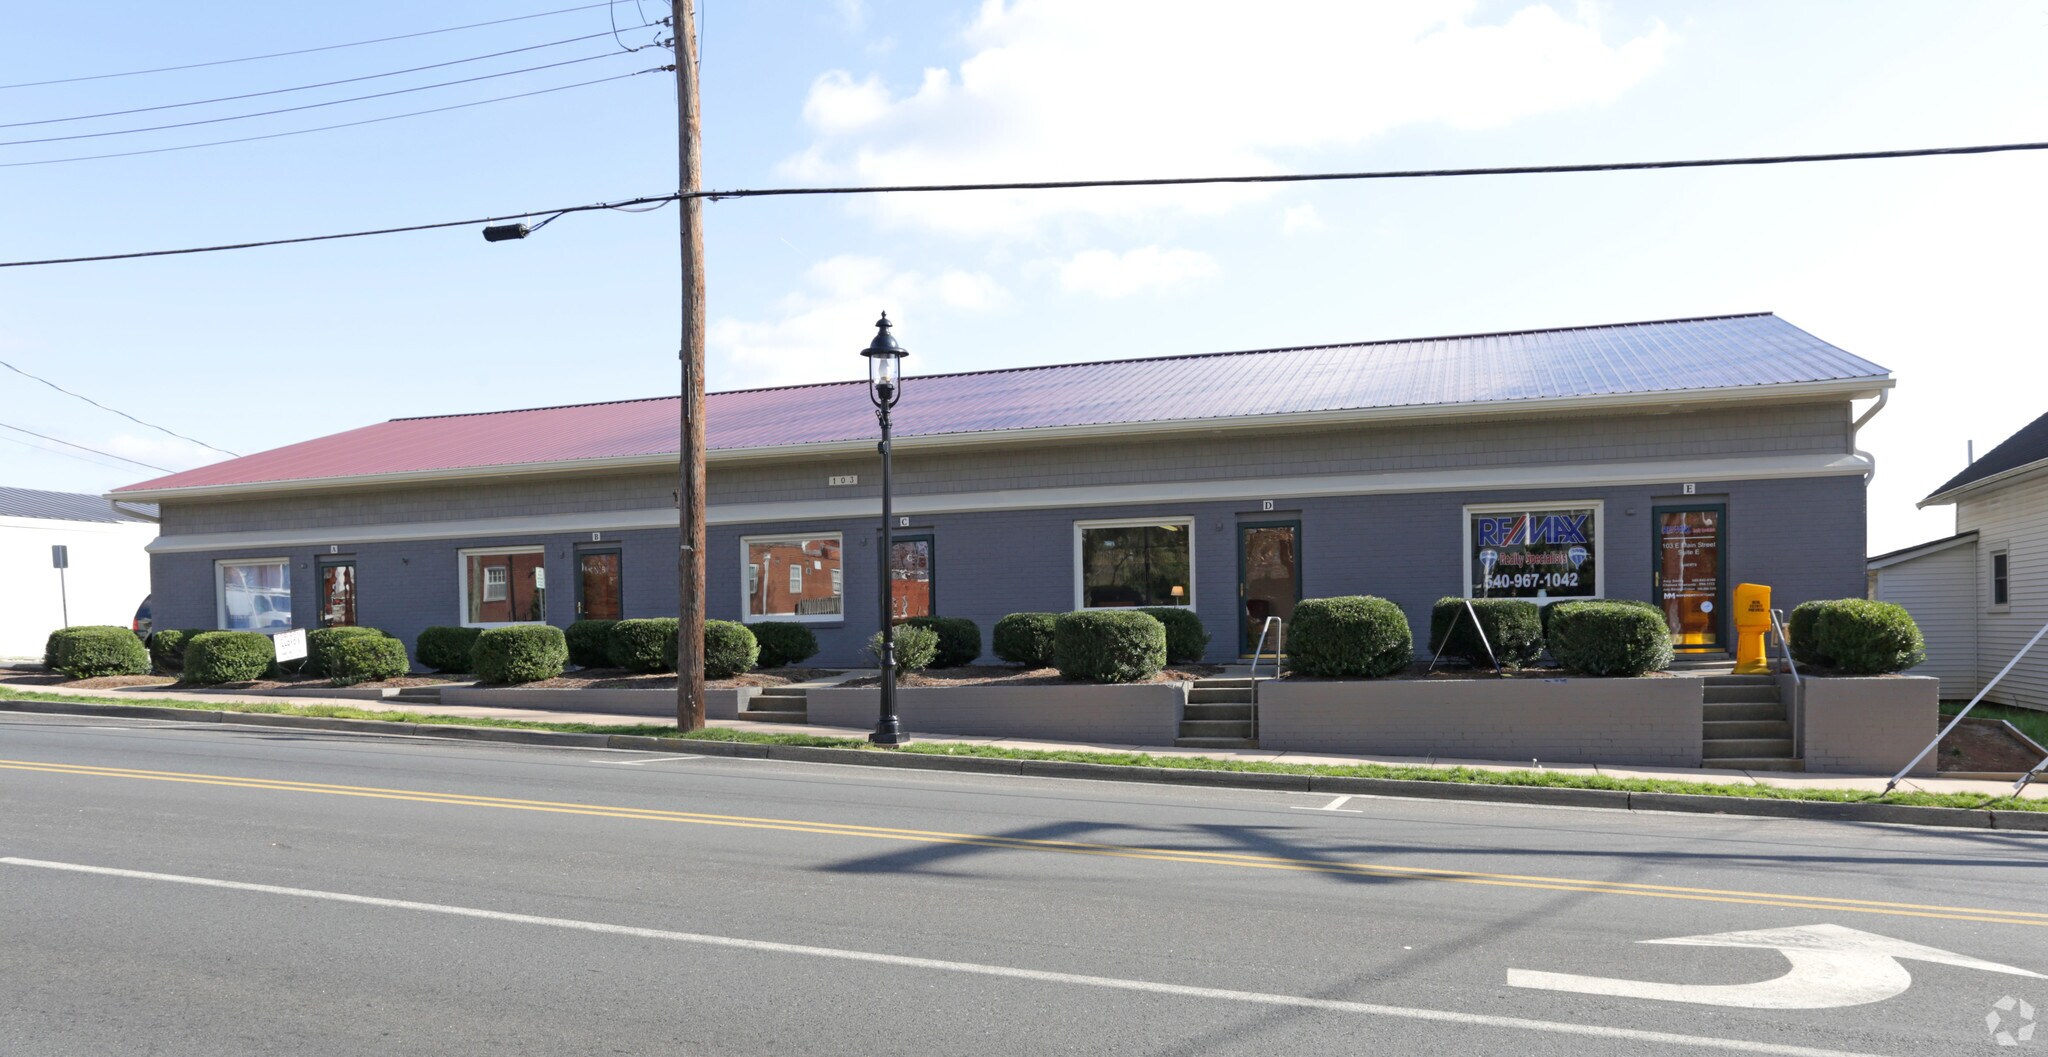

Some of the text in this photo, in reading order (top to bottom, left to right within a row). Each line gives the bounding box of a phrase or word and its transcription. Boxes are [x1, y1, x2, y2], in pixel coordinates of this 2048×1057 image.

[832, 476, 855, 485] 103
[1686, 484, 1694, 493] E
[1265, 501, 1272, 510] D
[901, 518, 908, 526] C
[1485, 572, 1579, 588] 540-967-1042
